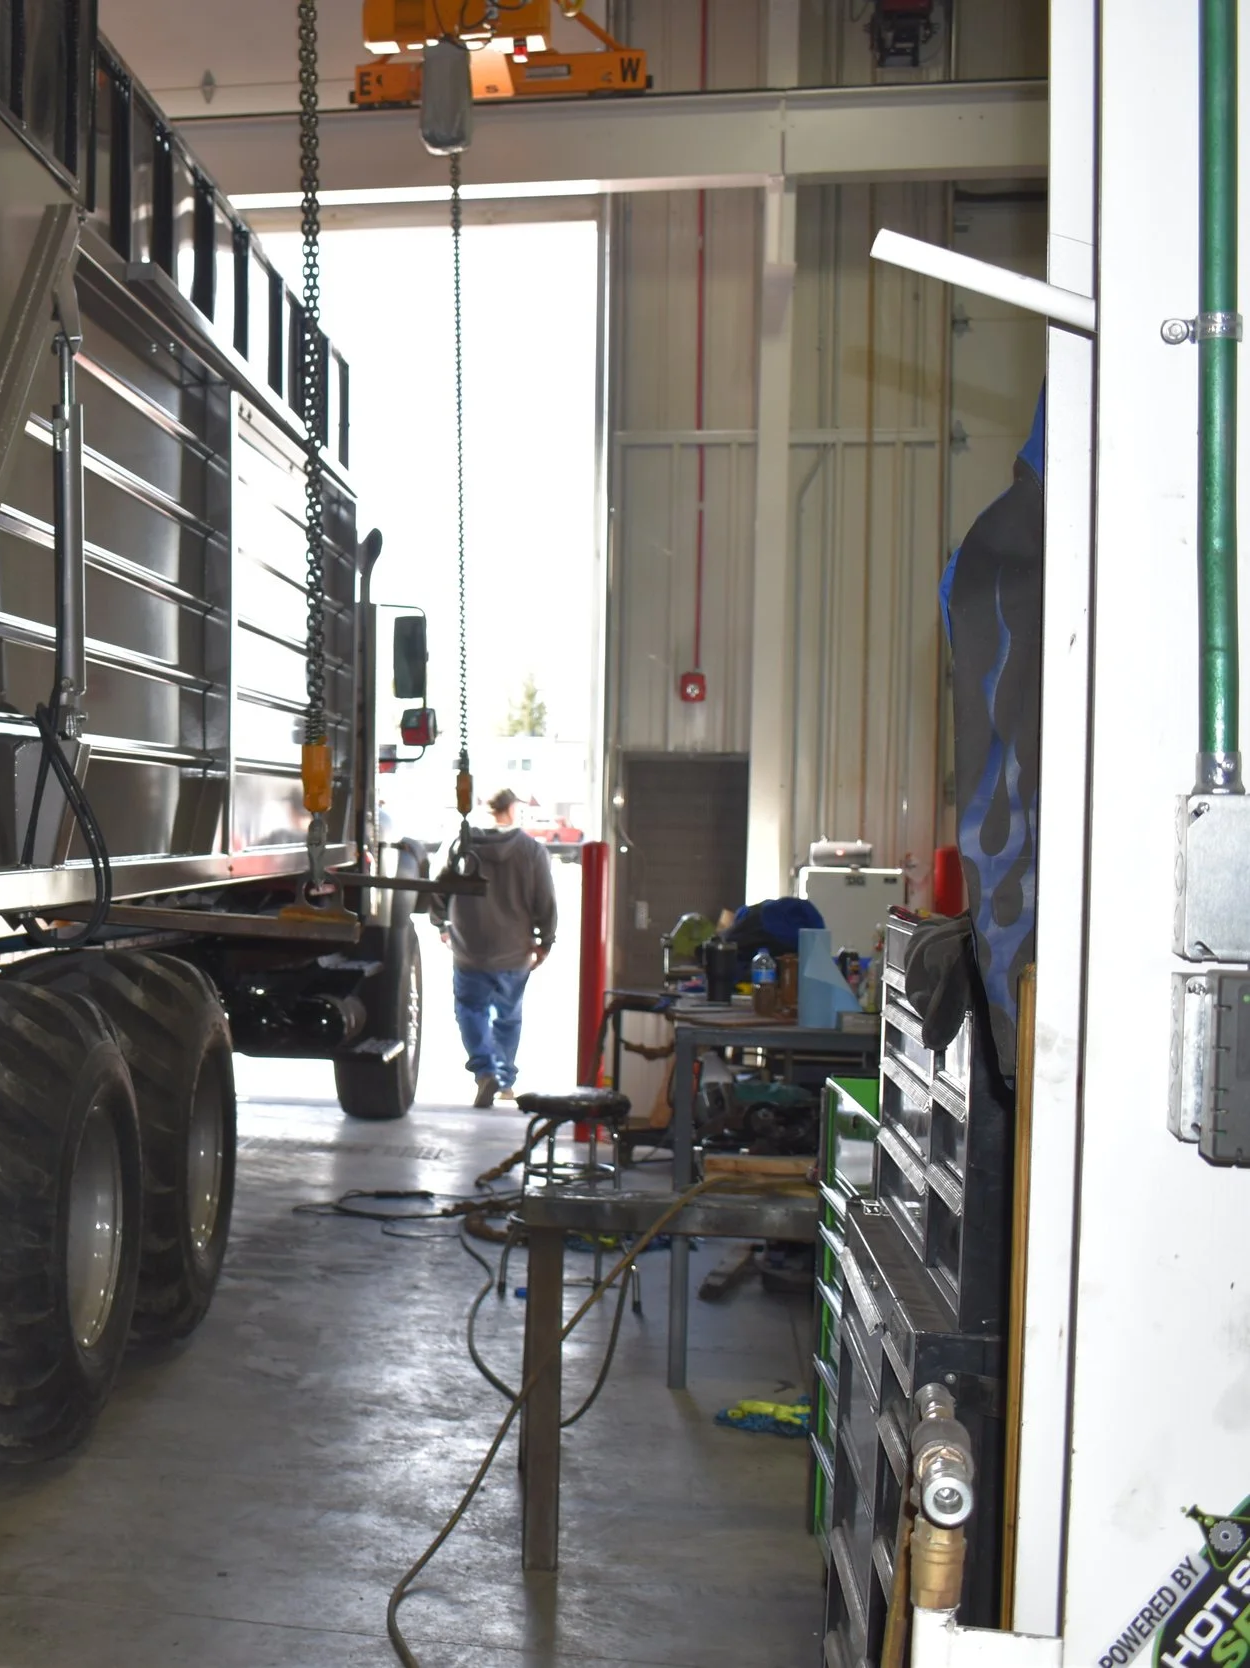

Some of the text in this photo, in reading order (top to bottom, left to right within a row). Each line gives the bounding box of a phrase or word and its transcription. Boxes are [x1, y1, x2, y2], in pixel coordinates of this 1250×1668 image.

[620, 57, 641, 83] W
[359, 71, 372, 97] E
[1098, 1555, 1200, 1668] POWERED BY
